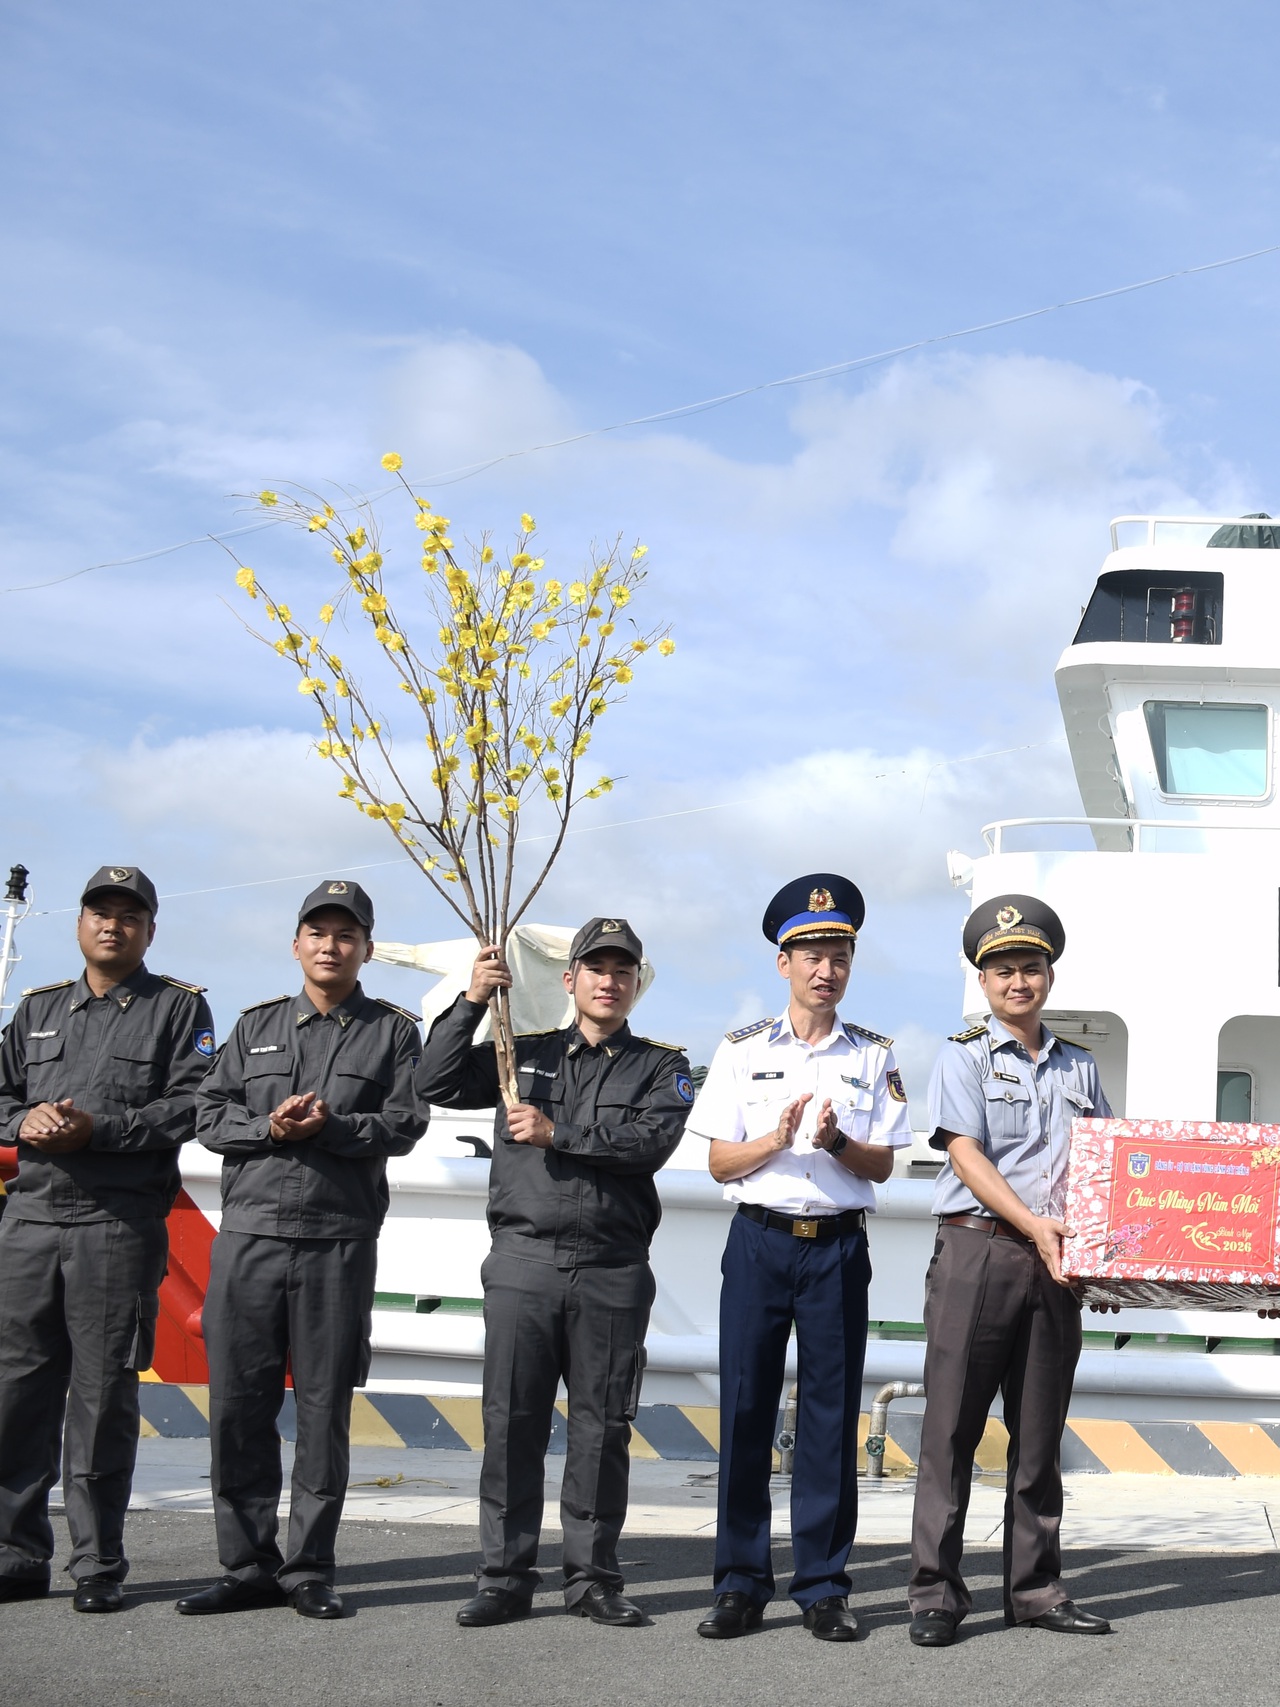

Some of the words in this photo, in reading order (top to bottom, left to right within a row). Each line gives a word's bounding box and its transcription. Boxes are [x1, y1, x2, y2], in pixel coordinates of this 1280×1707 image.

[1126, 1187, 1156, 1208] Chúc
[1158, 1189, 1195, 1214] Mừng
[1197, 1191, 1228, 1212] Năm
[1231, 1194, 1260, 1214] Mới
[1223, 1240, 1252, 1252] 2026
